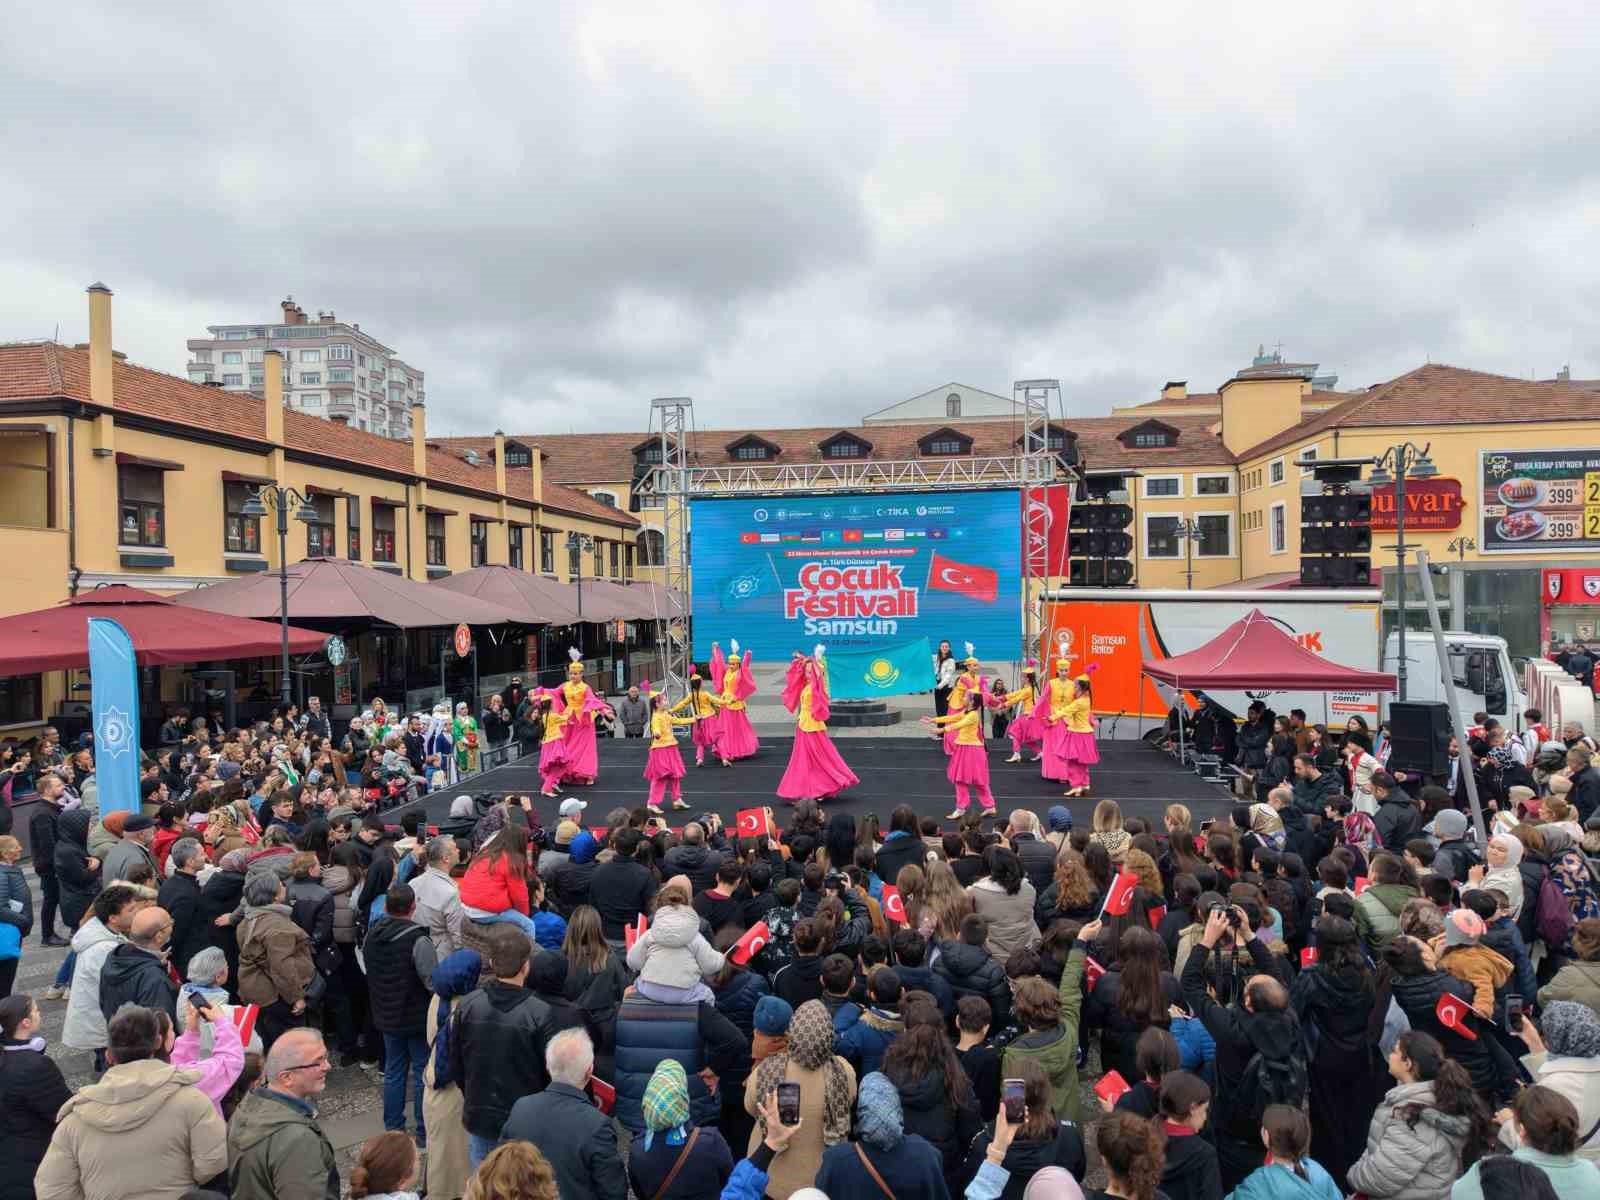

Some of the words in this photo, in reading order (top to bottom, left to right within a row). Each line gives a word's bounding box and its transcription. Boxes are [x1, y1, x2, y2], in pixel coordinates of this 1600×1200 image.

[1549, 488, 1573, 503] 399
[1588, 482, 1600, 502] 2
[1371, 493, 1456, 512] uvar
[1549, 523, 1573, 538] 399
[1588, 515, 1600, 535] 2
[799, 561, 904, 595] Çocuk
[784, 588, 918, 618] Festivali
[804, 618, 898, 635] Samsun
[1092, 634, 1126, 645] Samsun
